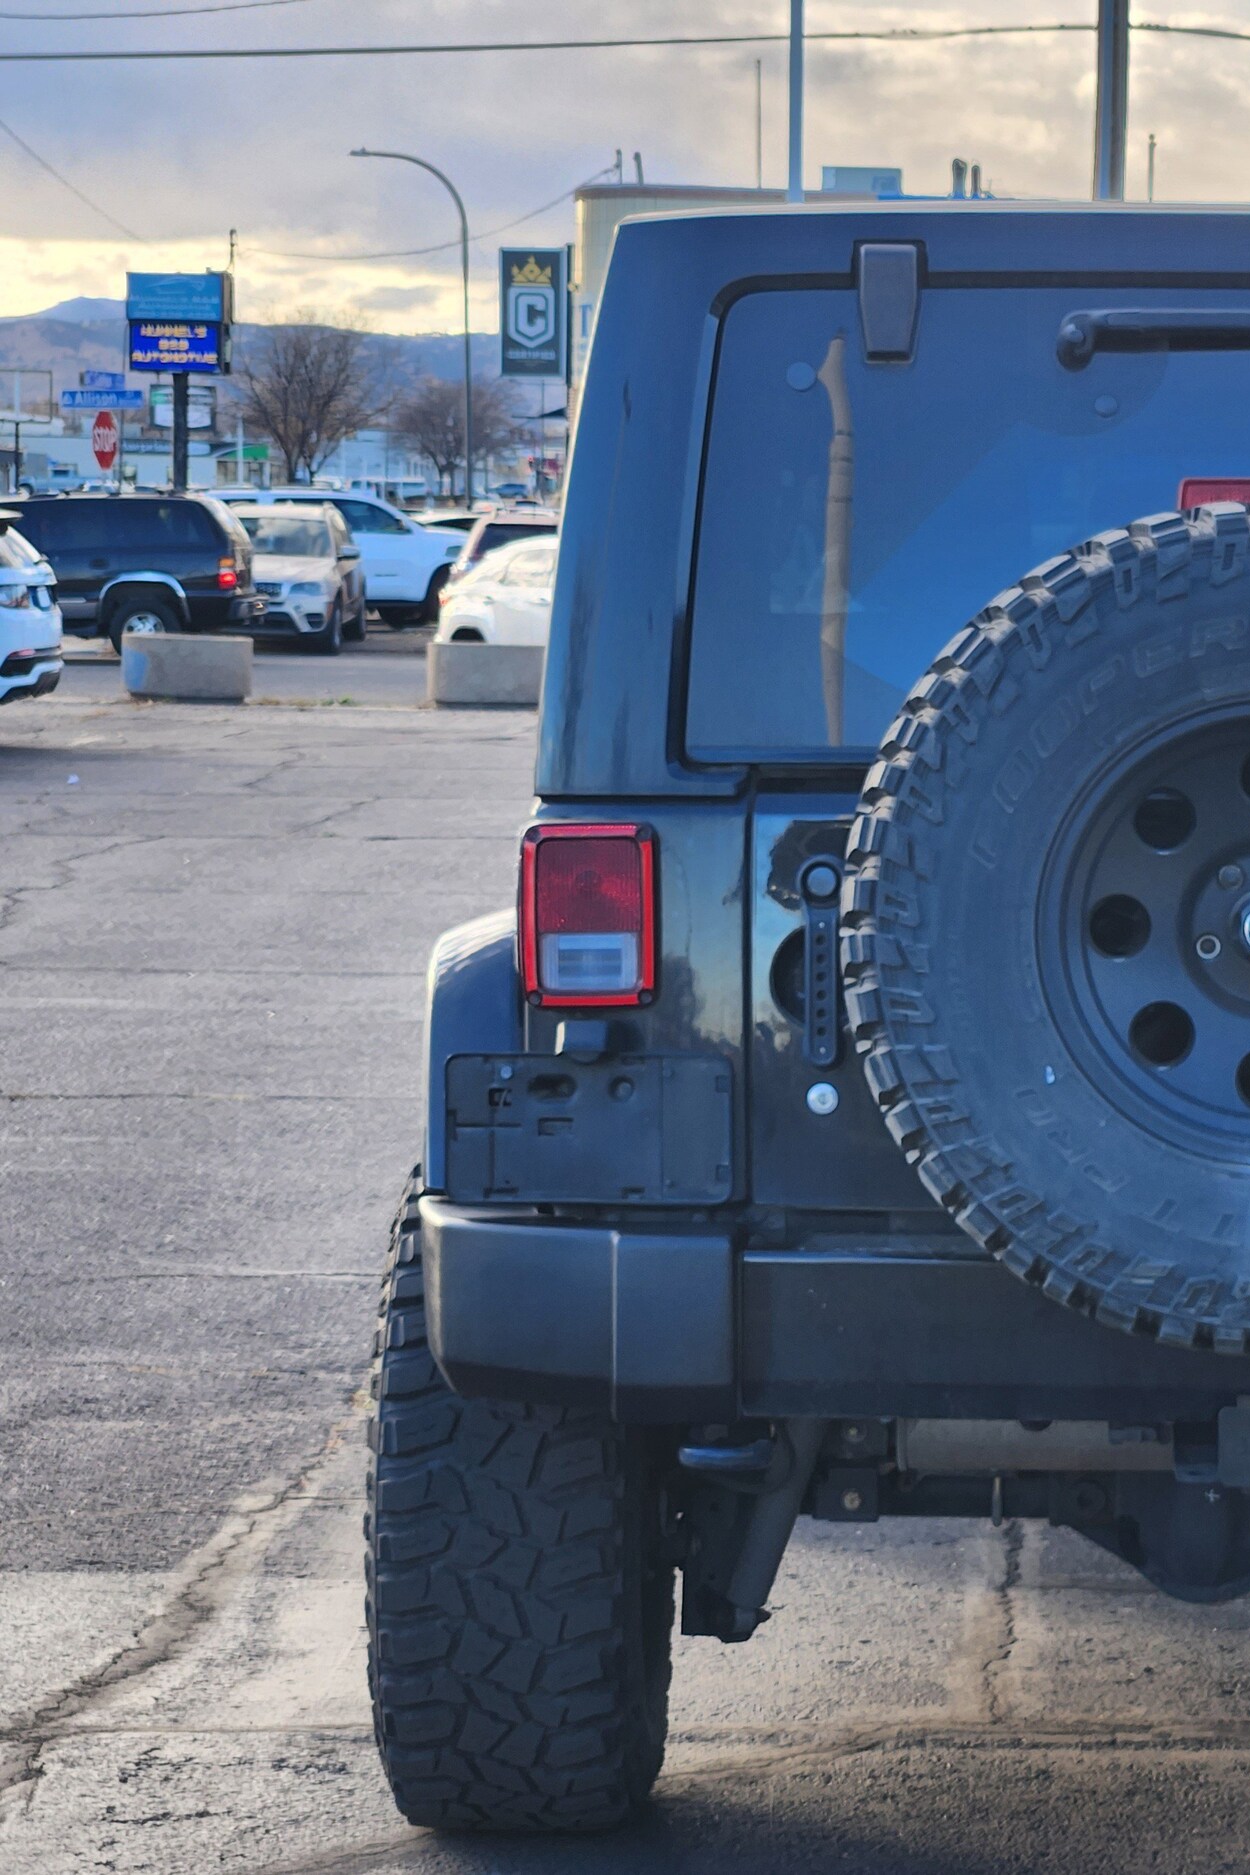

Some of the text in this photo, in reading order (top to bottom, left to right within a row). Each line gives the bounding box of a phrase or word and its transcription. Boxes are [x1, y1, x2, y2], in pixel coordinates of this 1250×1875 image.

[132, 351, 218, 364] AUTOMOTIVE
[74, 391, 118, 405] Allison
[93, 427, 117, 452] STOP
[968, 616, 1249, 870] COOPER
